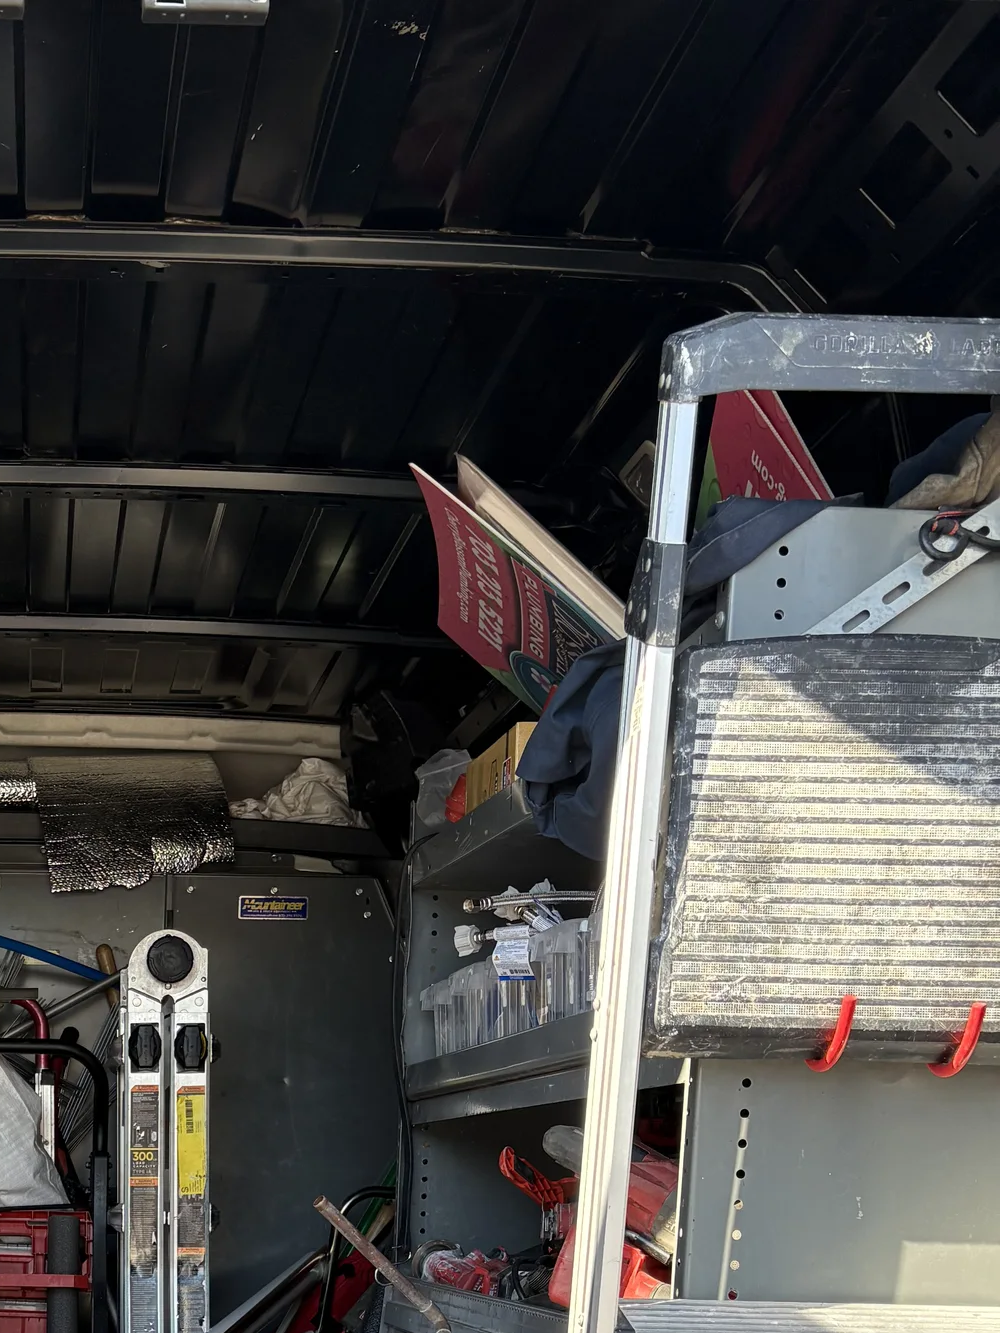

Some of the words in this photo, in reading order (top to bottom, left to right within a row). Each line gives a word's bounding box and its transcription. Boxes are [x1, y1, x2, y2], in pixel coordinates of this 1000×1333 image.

[751, 450, 786, 501] g.com
[464, 525, 499, 574] 703
[477, 599, 503, 653] 5221
[522, 570, 544, 660] PLUMBING
[242, 899, 305, 910] Mountaineer
[132, 1151, 154, 1161] 300
